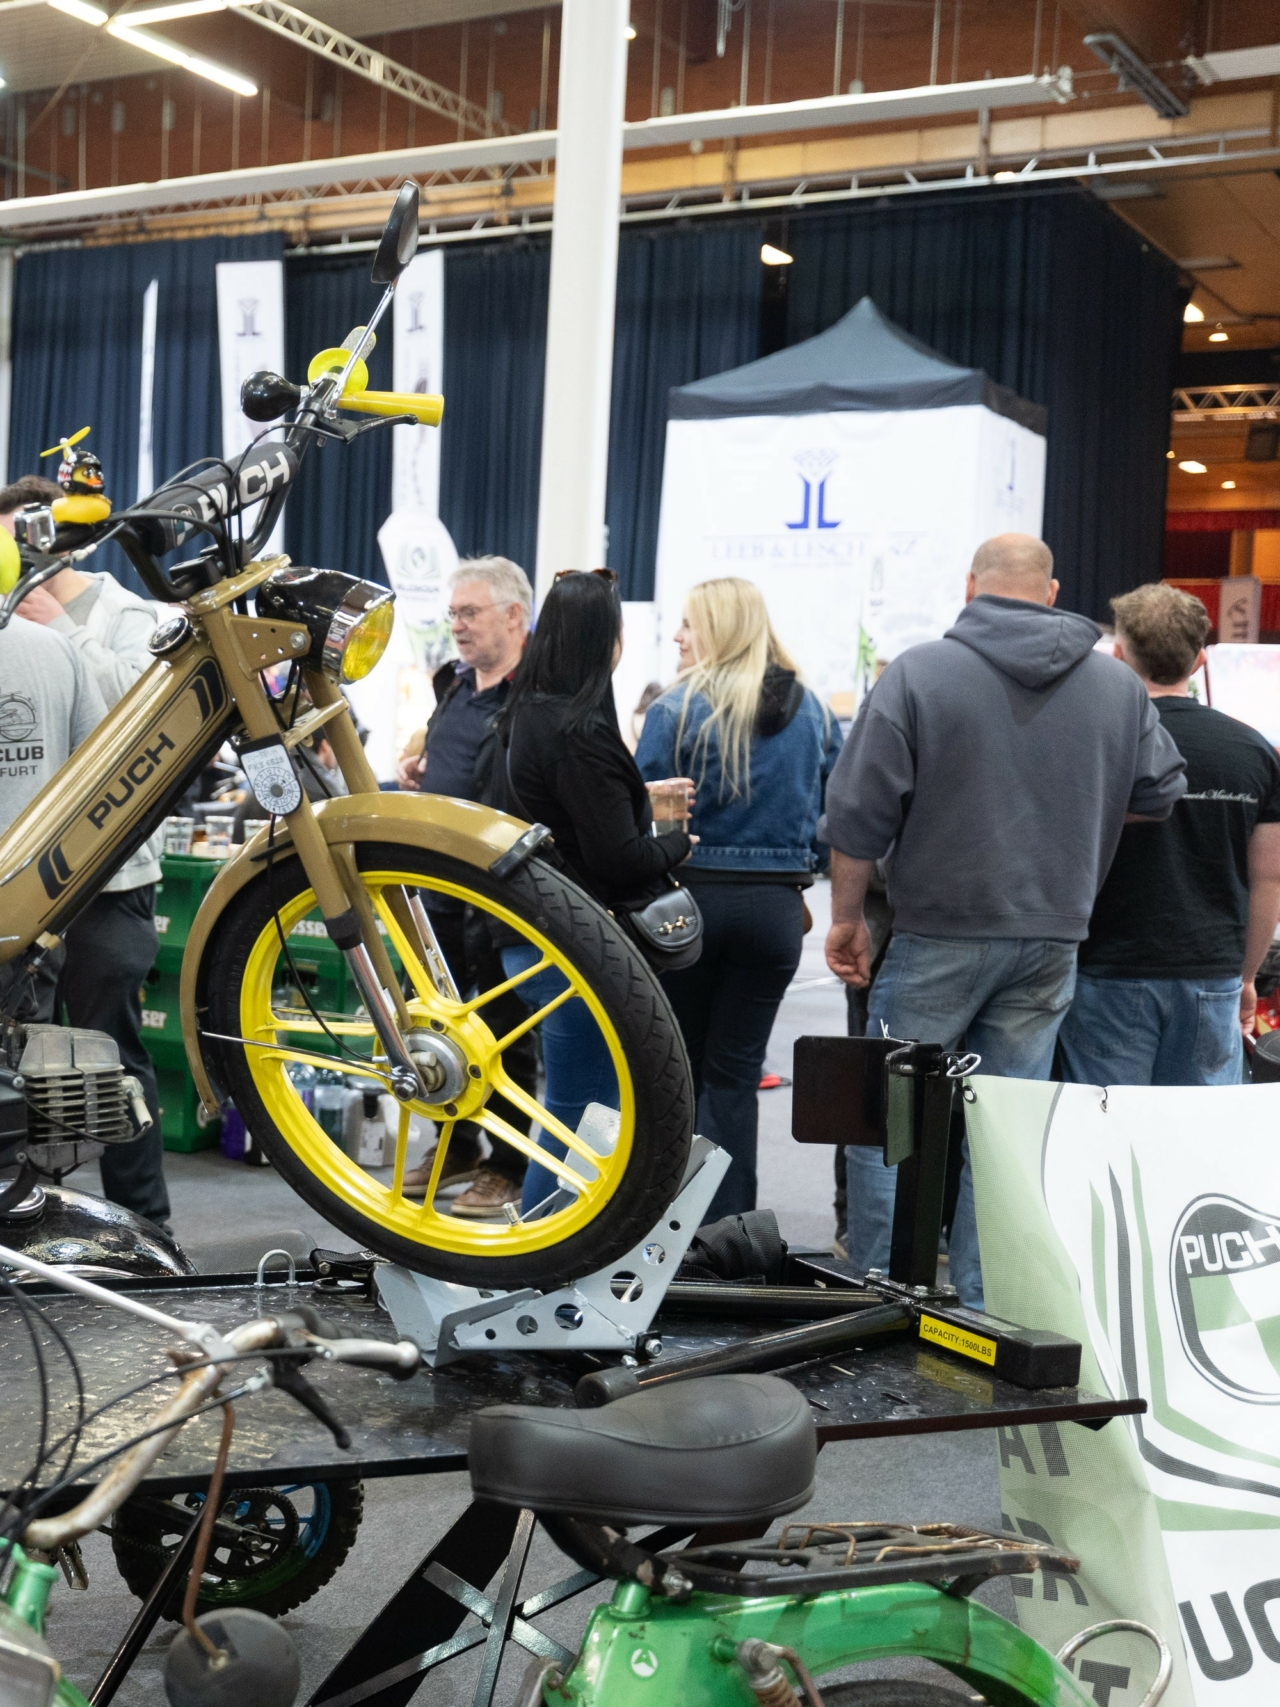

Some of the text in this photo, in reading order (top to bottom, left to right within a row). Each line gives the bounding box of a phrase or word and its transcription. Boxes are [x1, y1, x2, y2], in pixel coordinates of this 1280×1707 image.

[85, 730, 177, 831] PUCH
[1179, 1224, 1280, 1275] PUCH
[922, 1322, 993, 1358] CAPACITY:1500LBS
